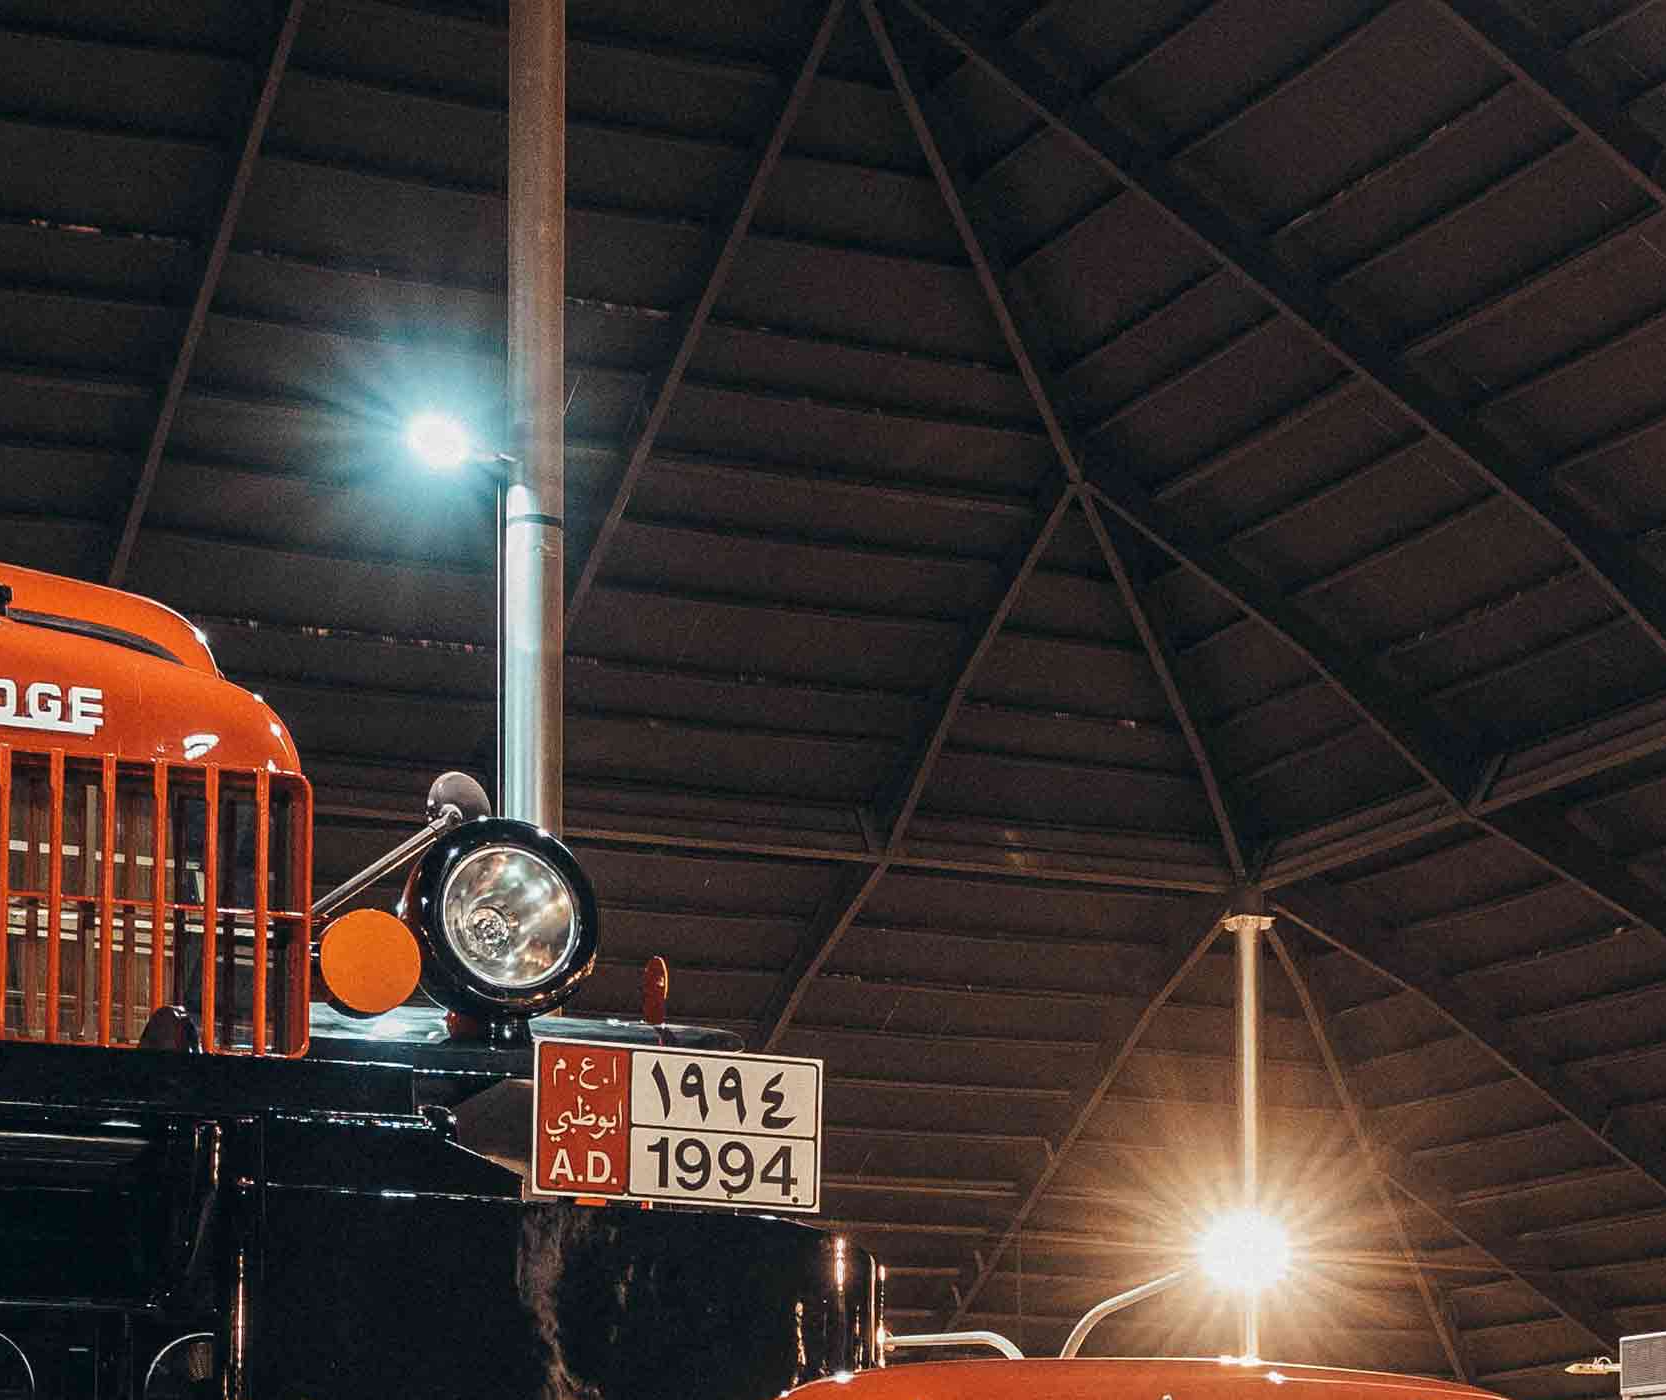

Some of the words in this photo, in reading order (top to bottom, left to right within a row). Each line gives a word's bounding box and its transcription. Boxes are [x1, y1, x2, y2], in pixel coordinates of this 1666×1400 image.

[651, 1059, 797, 1129] ١٩٩٤
[549, 1148, 618, 1184] A.D.
[647, 1136, 798, 1197] 1994
